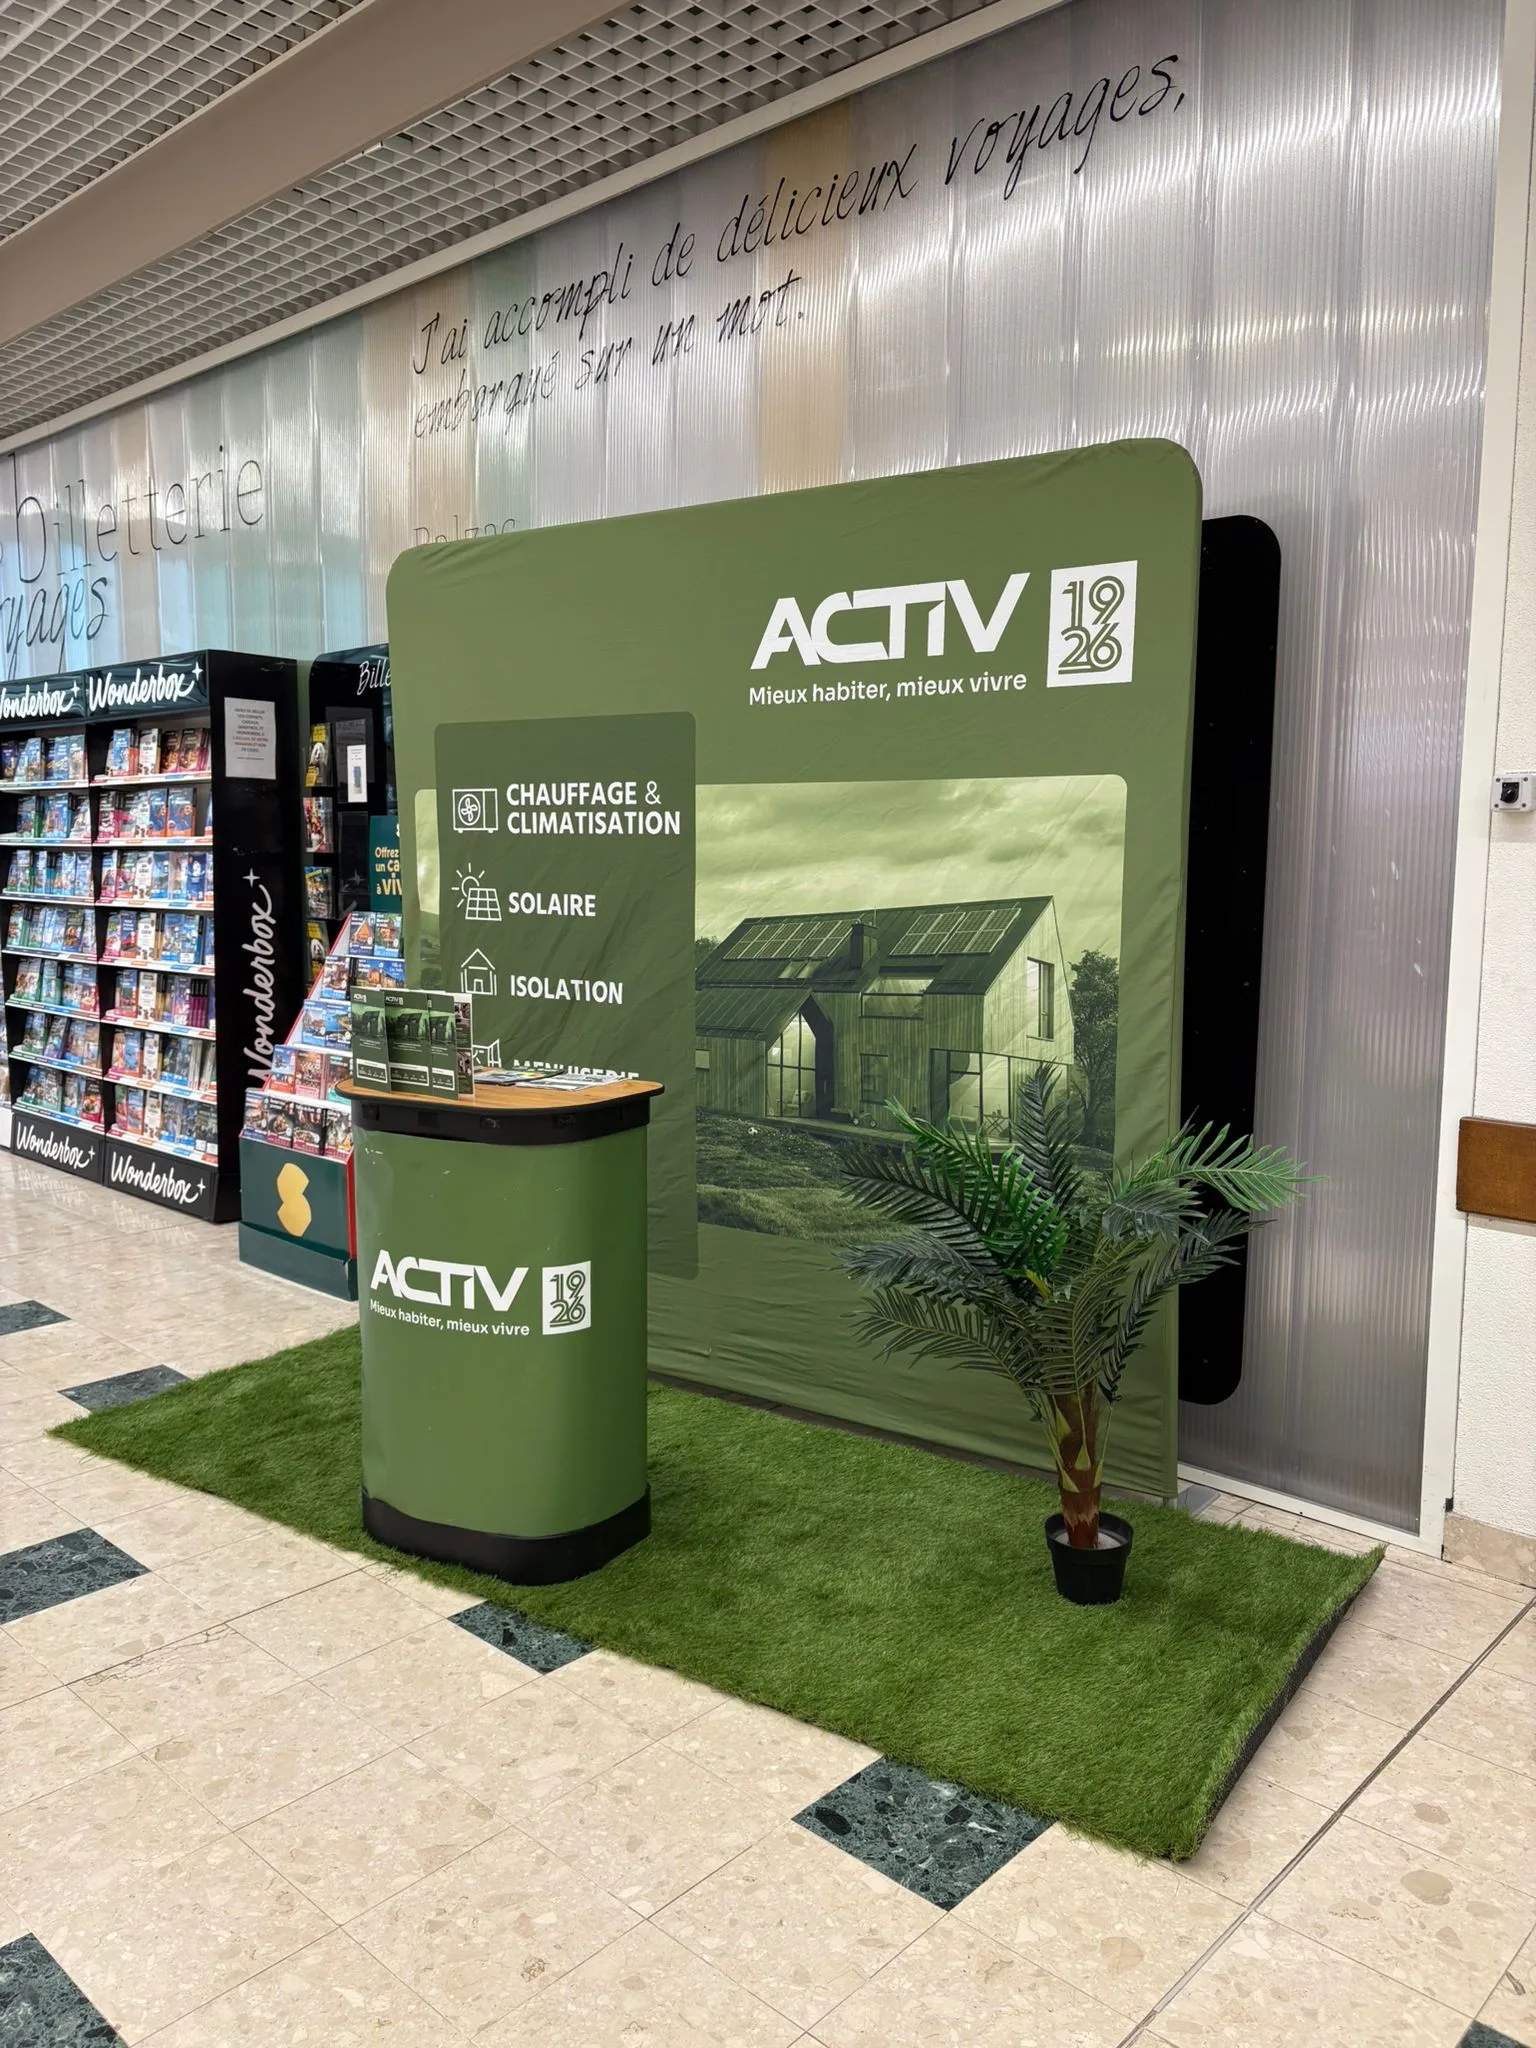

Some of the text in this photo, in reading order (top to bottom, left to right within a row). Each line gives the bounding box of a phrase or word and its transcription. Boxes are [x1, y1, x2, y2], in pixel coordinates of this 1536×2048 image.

[413, 54, 1186, 374] J'ai accompli de délicieux voyages,
[414, 269, 804, 438] embarqué sur un mot.
[8, 444, 265, 584] billetterie
[750, 571, 1031, 670] ACTIV
[88, 663, 195, 712] Wonderbox
[749, 672, 1027, 706] Mieux habiter, mieux vivre
[506, 780, 662, 806] CHAUFFAGE &
[507, 810, 681, 835] CLIMATISATION
[375, 847, 399, 859] Offrez
[375, 863, 386, 872] un
[508, 892, 597, 917] SOLAIRE
[510, 974, 624, 1005] ISOLATION
[16, 1121, 91, 1170] Wonderbox
[110, 1151, 200, 1205] Wonderbox
[370, 1249, 530, 1312] ACTIV
[370, 1298, 530, 1336] Mieux habiter, mieux vivre
